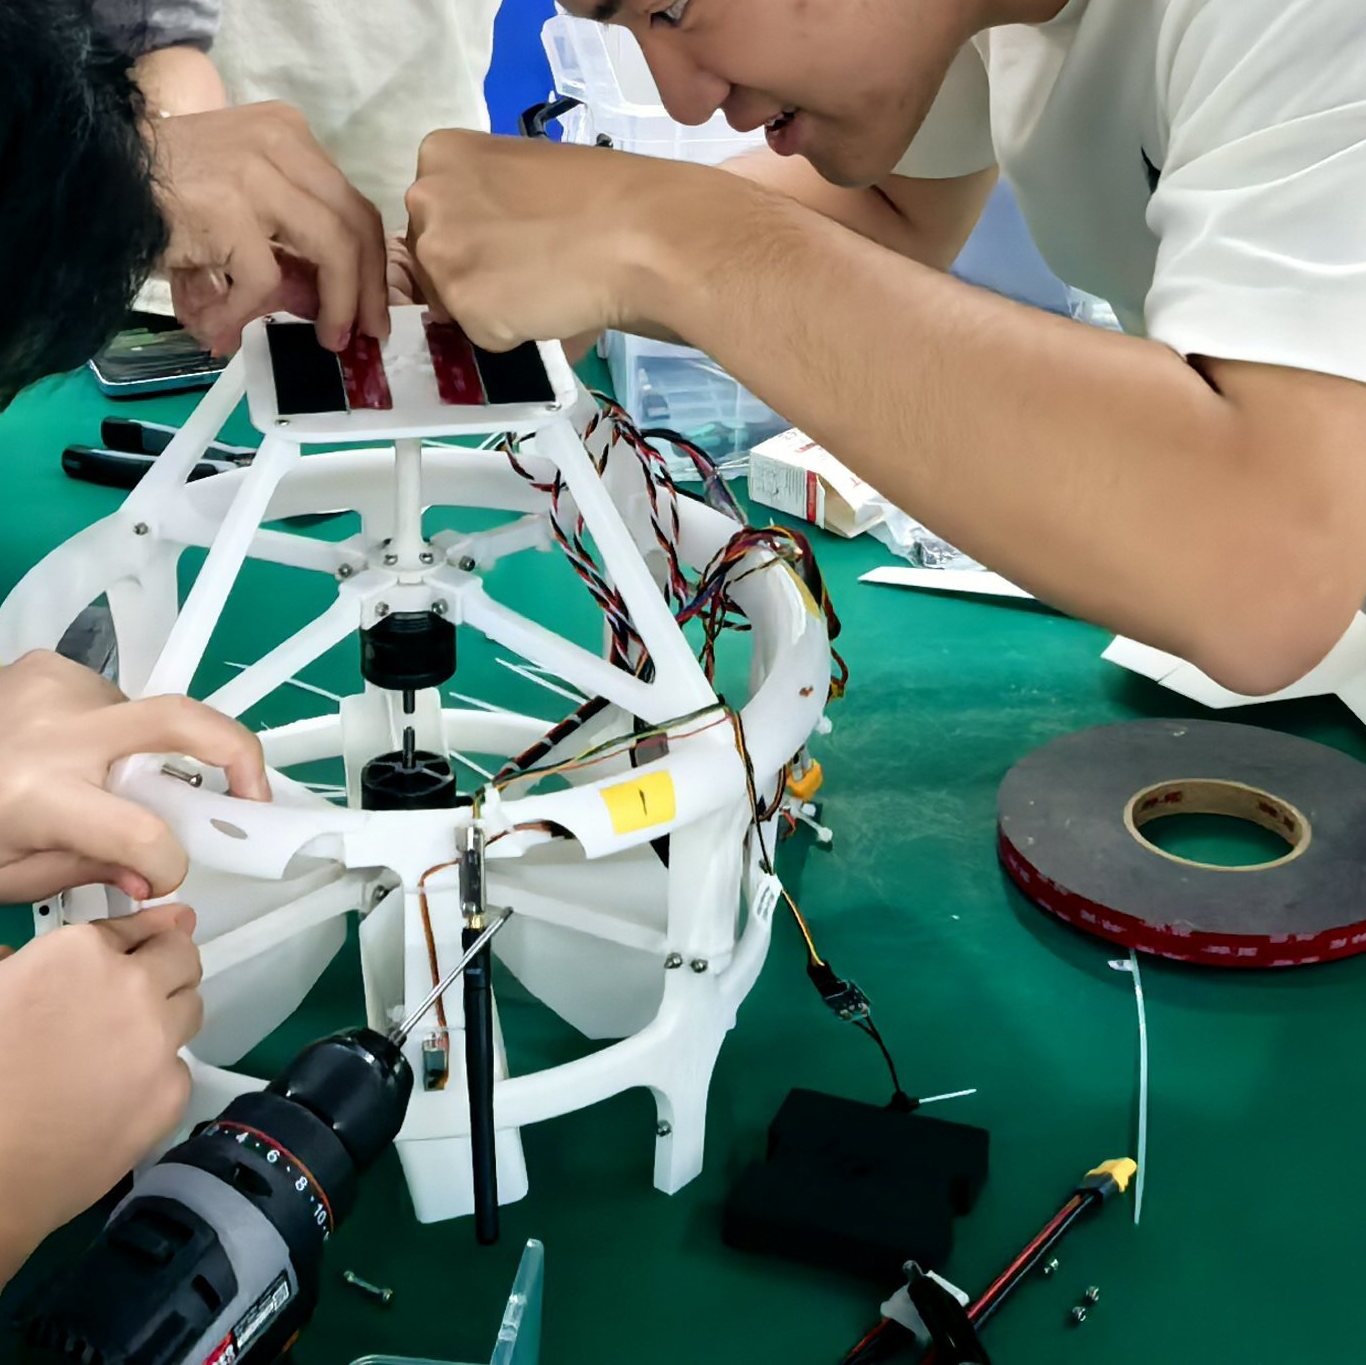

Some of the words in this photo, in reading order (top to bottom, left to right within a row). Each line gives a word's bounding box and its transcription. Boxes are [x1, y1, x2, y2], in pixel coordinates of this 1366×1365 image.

[236, 1131, 249, 1144] 4
[266, 1149, 281, 1164] 6
[294, 1175, 309, 1191] 8
[313, 1202, 328, 1226] 10
